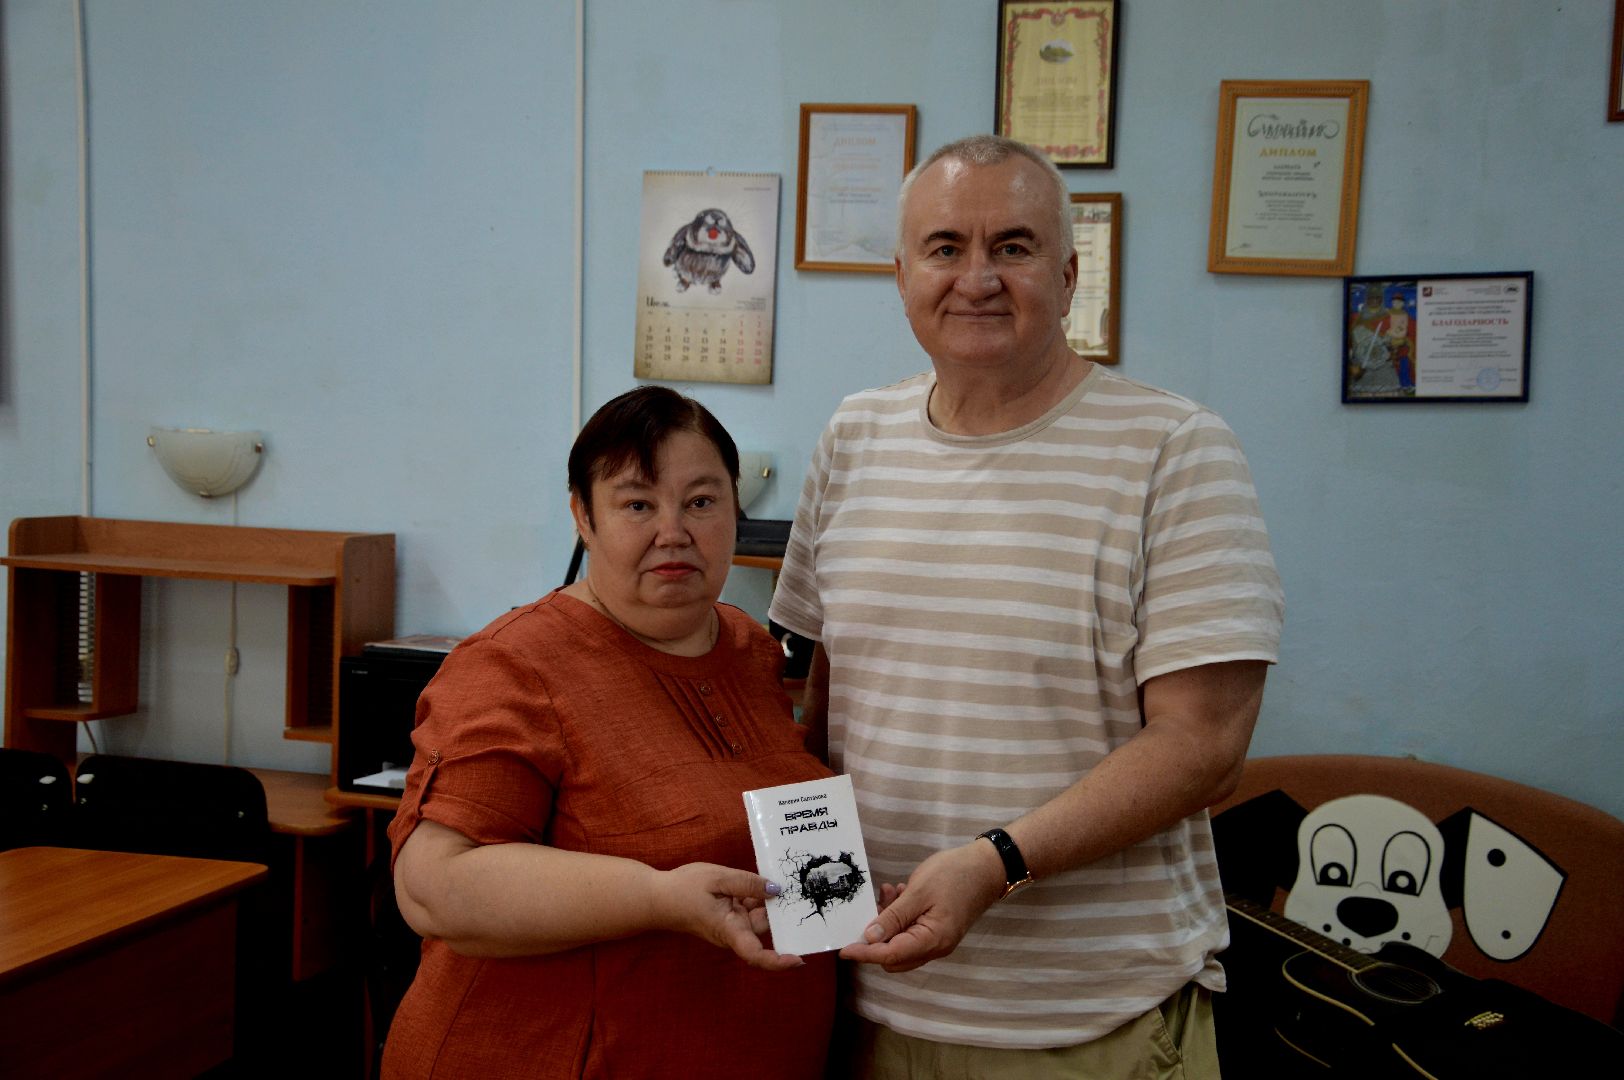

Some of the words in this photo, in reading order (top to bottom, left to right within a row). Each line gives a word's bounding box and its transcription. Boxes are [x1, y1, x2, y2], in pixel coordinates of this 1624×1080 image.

[1258, 148, 1317, 159] ДИПЛОМ
[1432, 318, 1509, 327] БЛАГОДАРНОСТЬ
[784, 807, 829, 821] ВРЕМЯ
[780, 819, 838, 836] ПРАВДЫ
